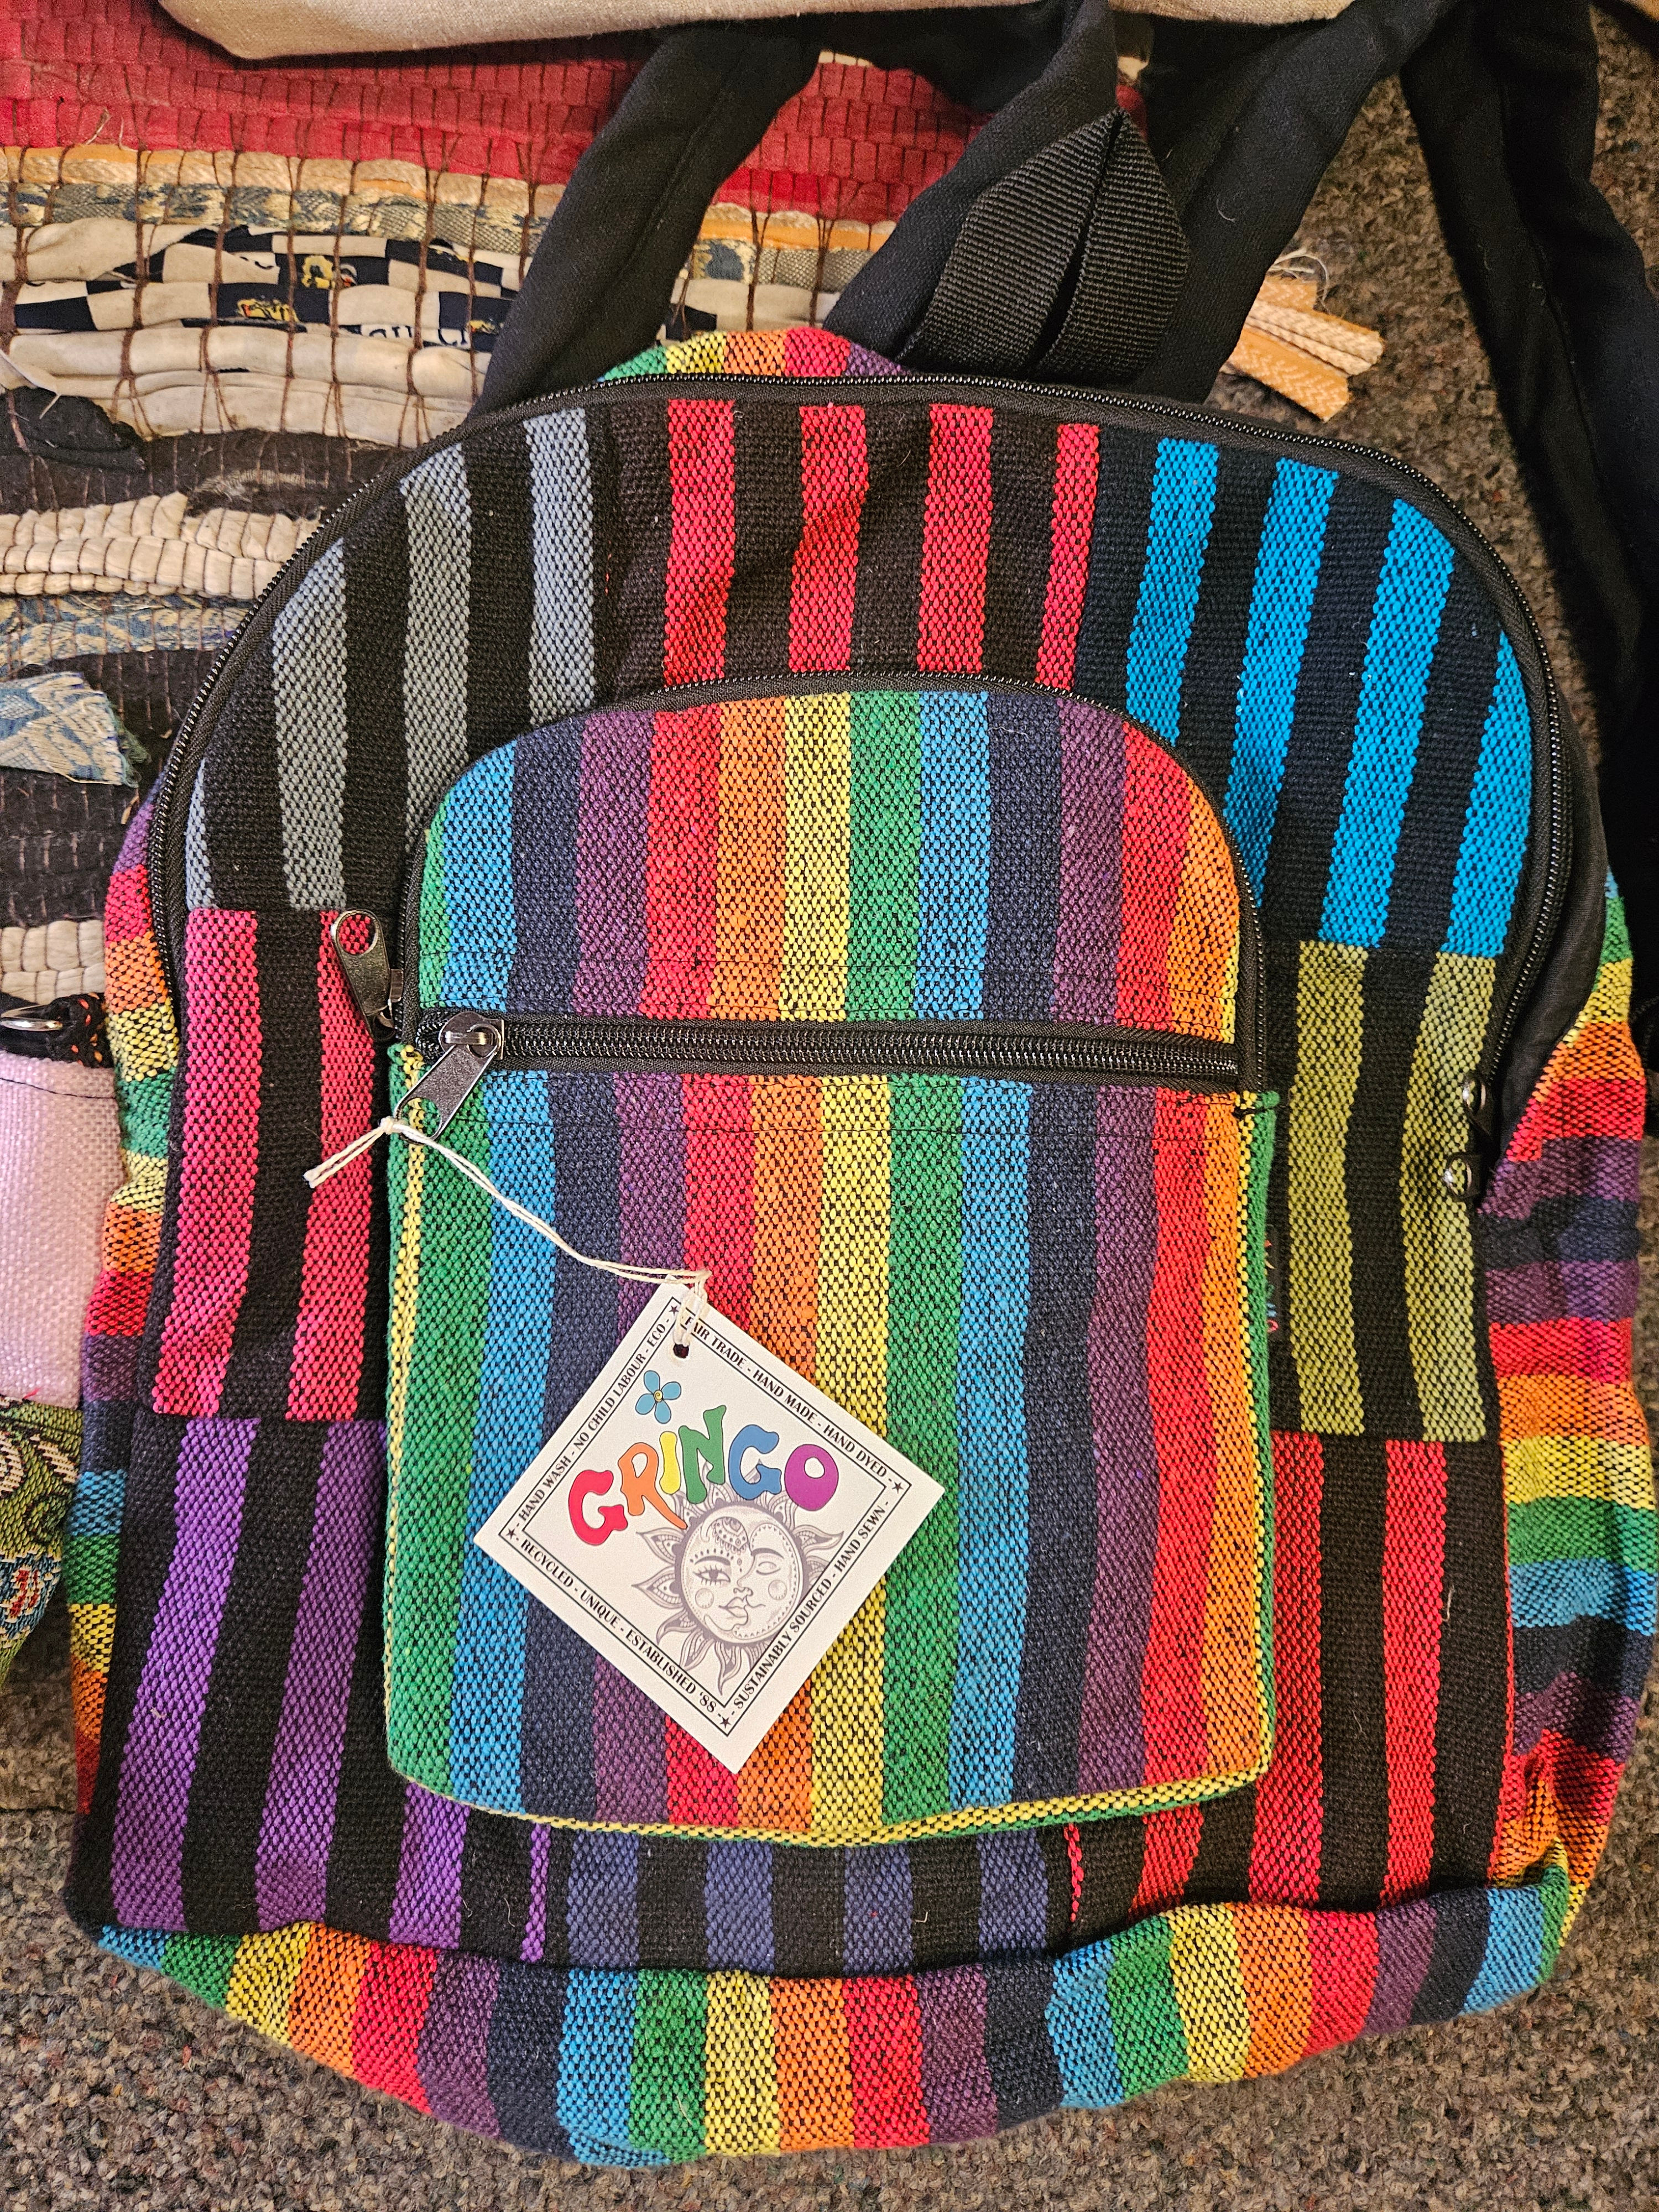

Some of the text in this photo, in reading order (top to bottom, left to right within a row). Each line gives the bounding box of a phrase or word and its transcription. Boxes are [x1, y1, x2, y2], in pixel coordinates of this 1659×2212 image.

[519, 1323, 666, 1521] HAND WASH NO CHILD LABOUR ECO
[568, 1405, 839, 1546] GRINGO
[711, 1335, 747, 1369] TRADE
[753, 1370, 784, 1397] HAND
[784, 1395, 817, 1423] MADE
[823, 1425, 855, 1452] HAND
[855, 1450, 887, 1478] DYED
[520, 1539, 573, 1587] RECYCLED
[580, 1590, 620, 1629] UNIQUE
[625, 1629, 696, 1694] ESTABLISHED
[734, 1505, 885, 1709] SUSTAINABLY SOURCED HAND SEWN
